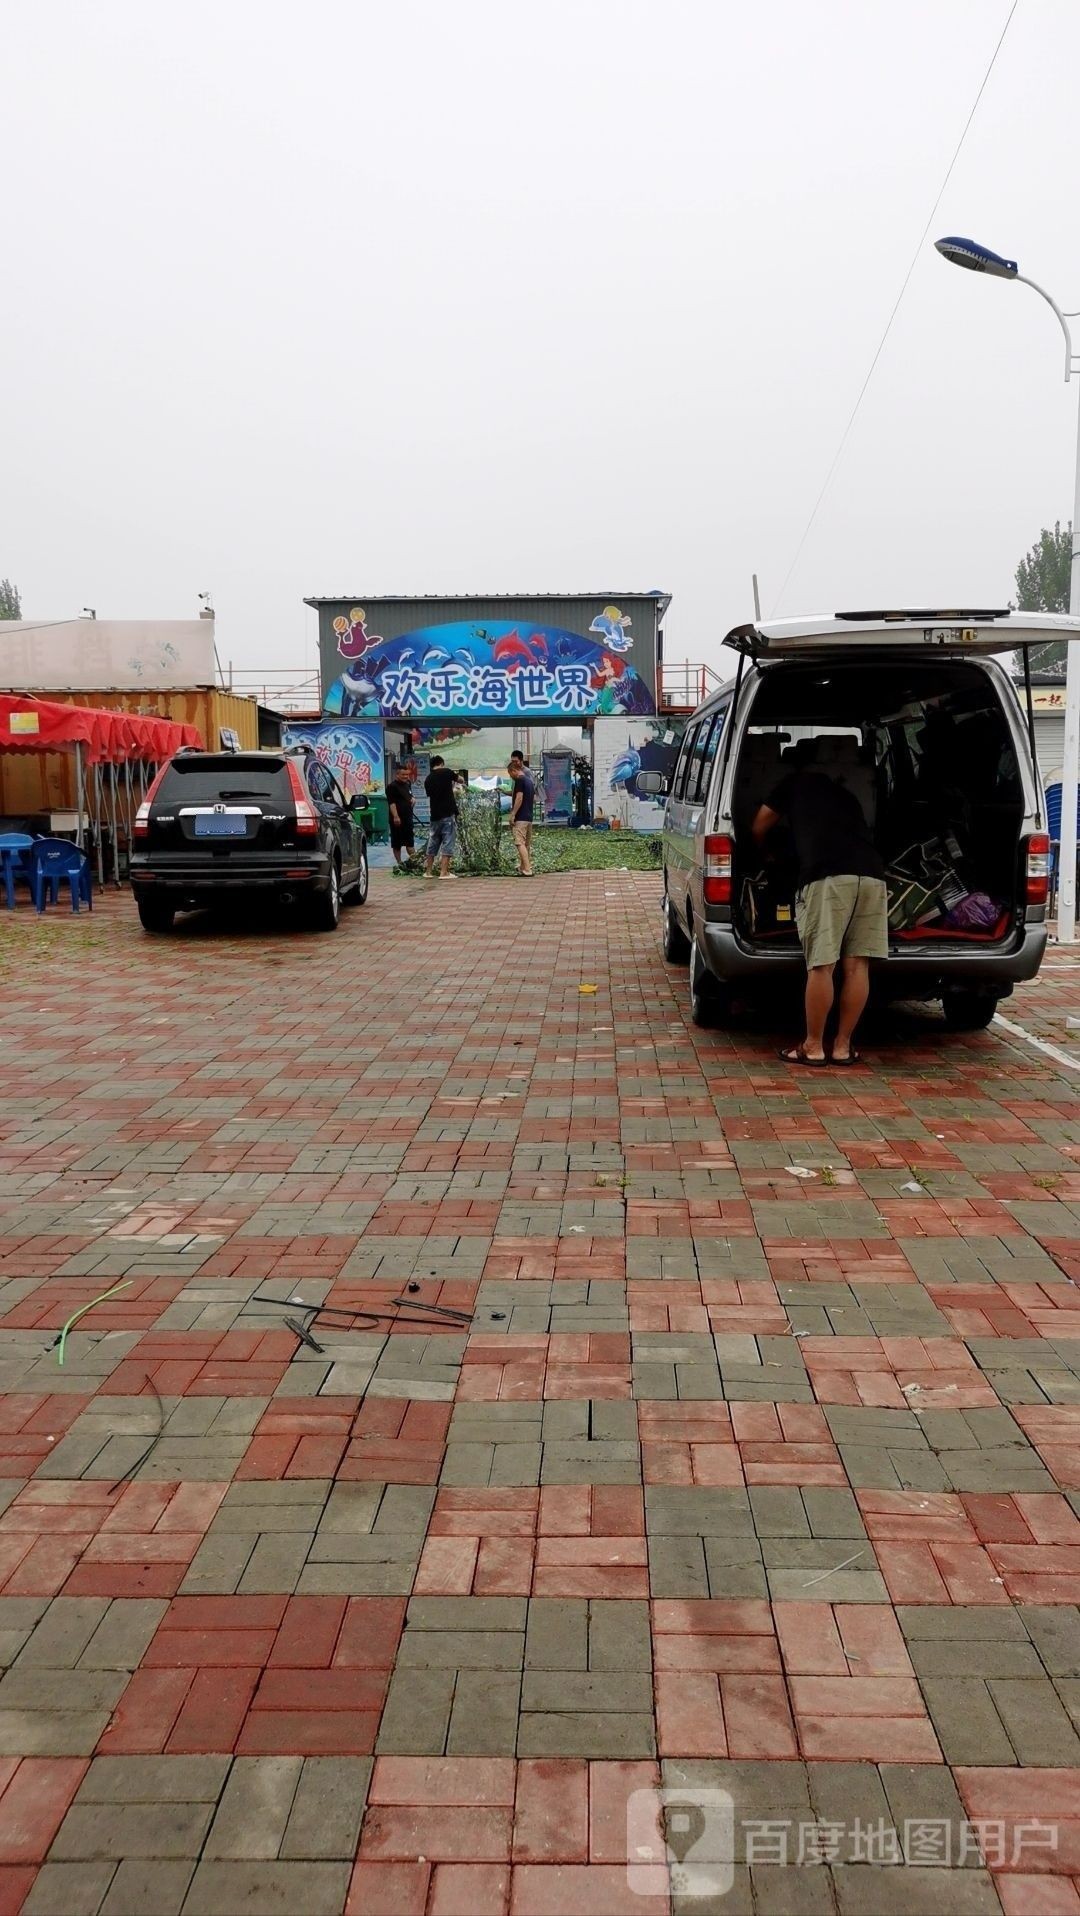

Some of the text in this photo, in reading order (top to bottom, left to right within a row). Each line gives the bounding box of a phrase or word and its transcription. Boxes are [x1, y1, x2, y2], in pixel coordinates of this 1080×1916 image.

[383, 665, 597, 710] 欢乐海世界
[1033, 694, 1066, 707] 一起
[315, 745, 371, 783] 欢迎您
